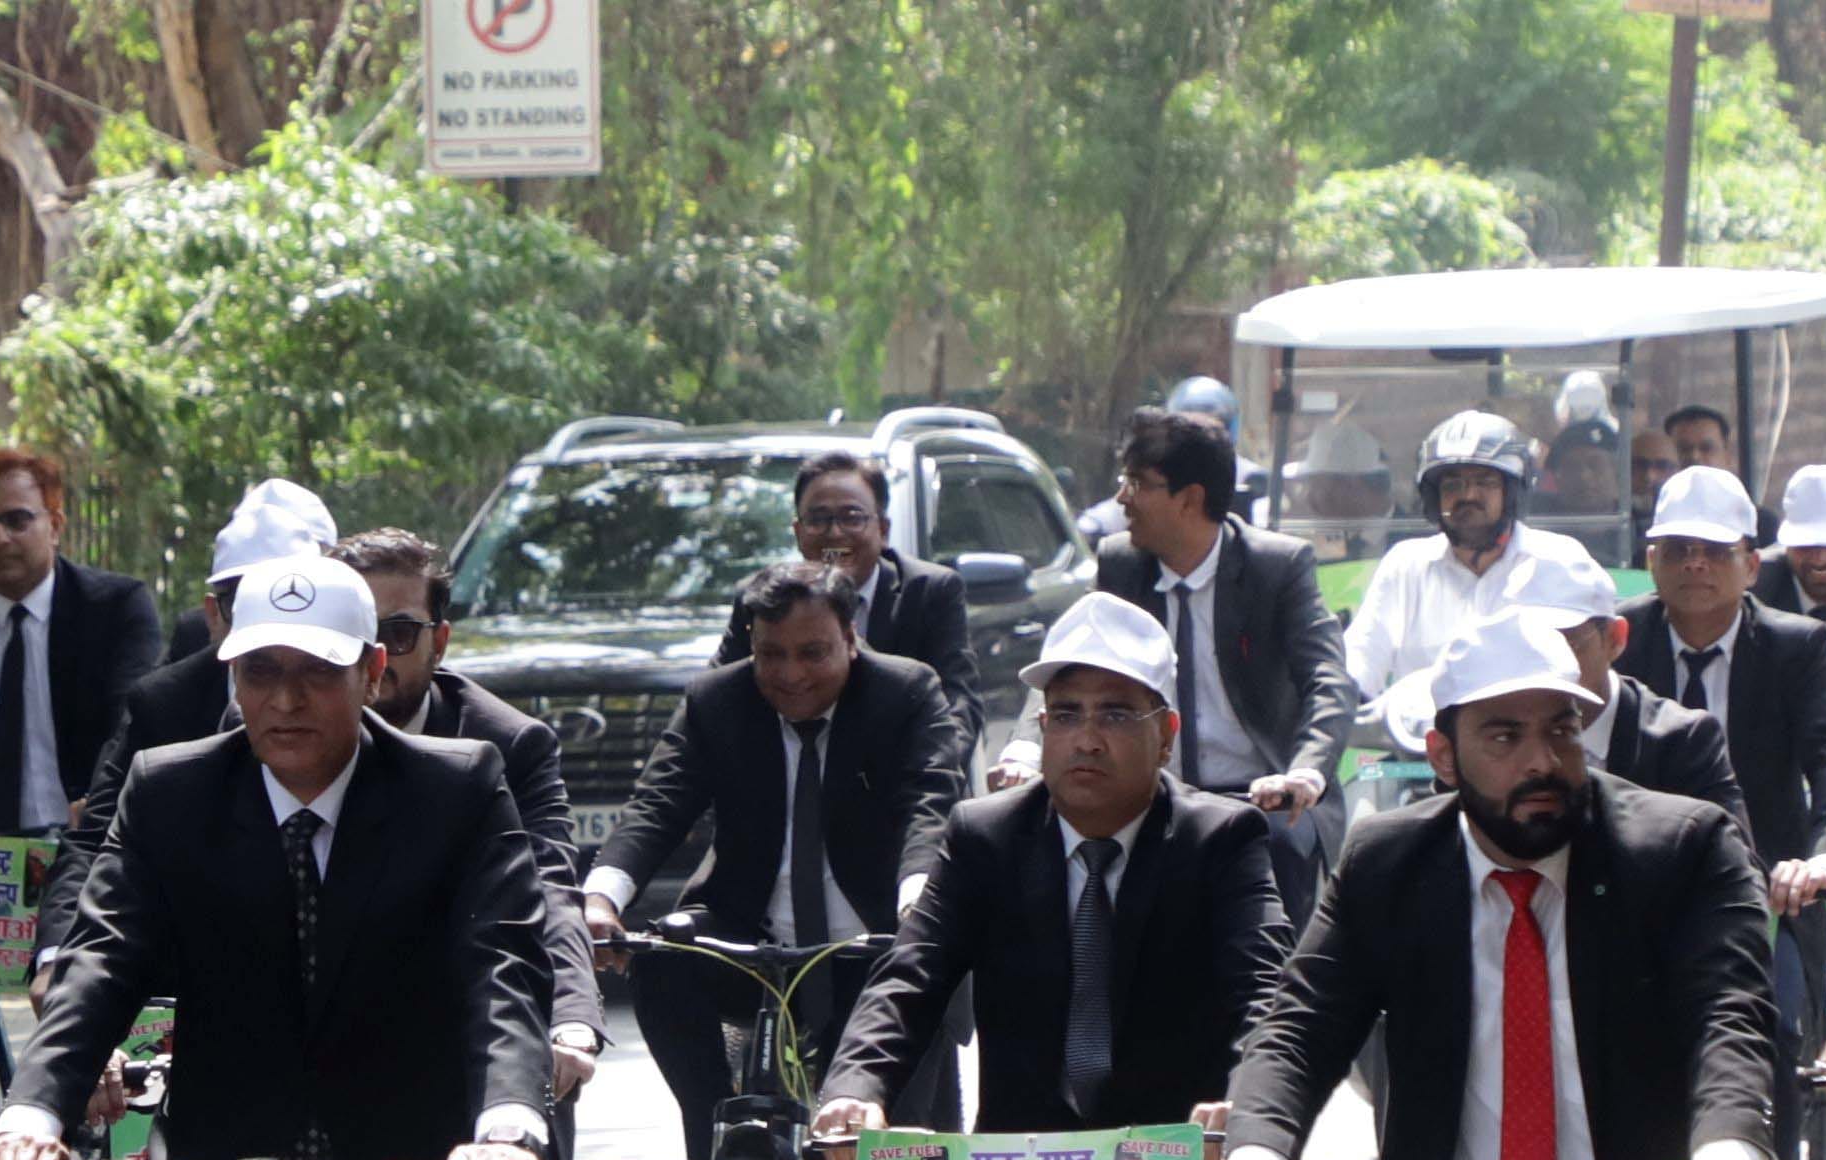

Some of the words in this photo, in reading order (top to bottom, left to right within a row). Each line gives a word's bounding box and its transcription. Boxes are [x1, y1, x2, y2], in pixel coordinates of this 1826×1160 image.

[443, 71, 474, 91] NO
[482, 69, 579, 91] PARKING
[438, 109, 468, 127] NO
[477, 106, 585, 127] STANDING
[871, 1149, 901, 1160] SAVE
[1123, 1140, 1154, 1153] SAVE
